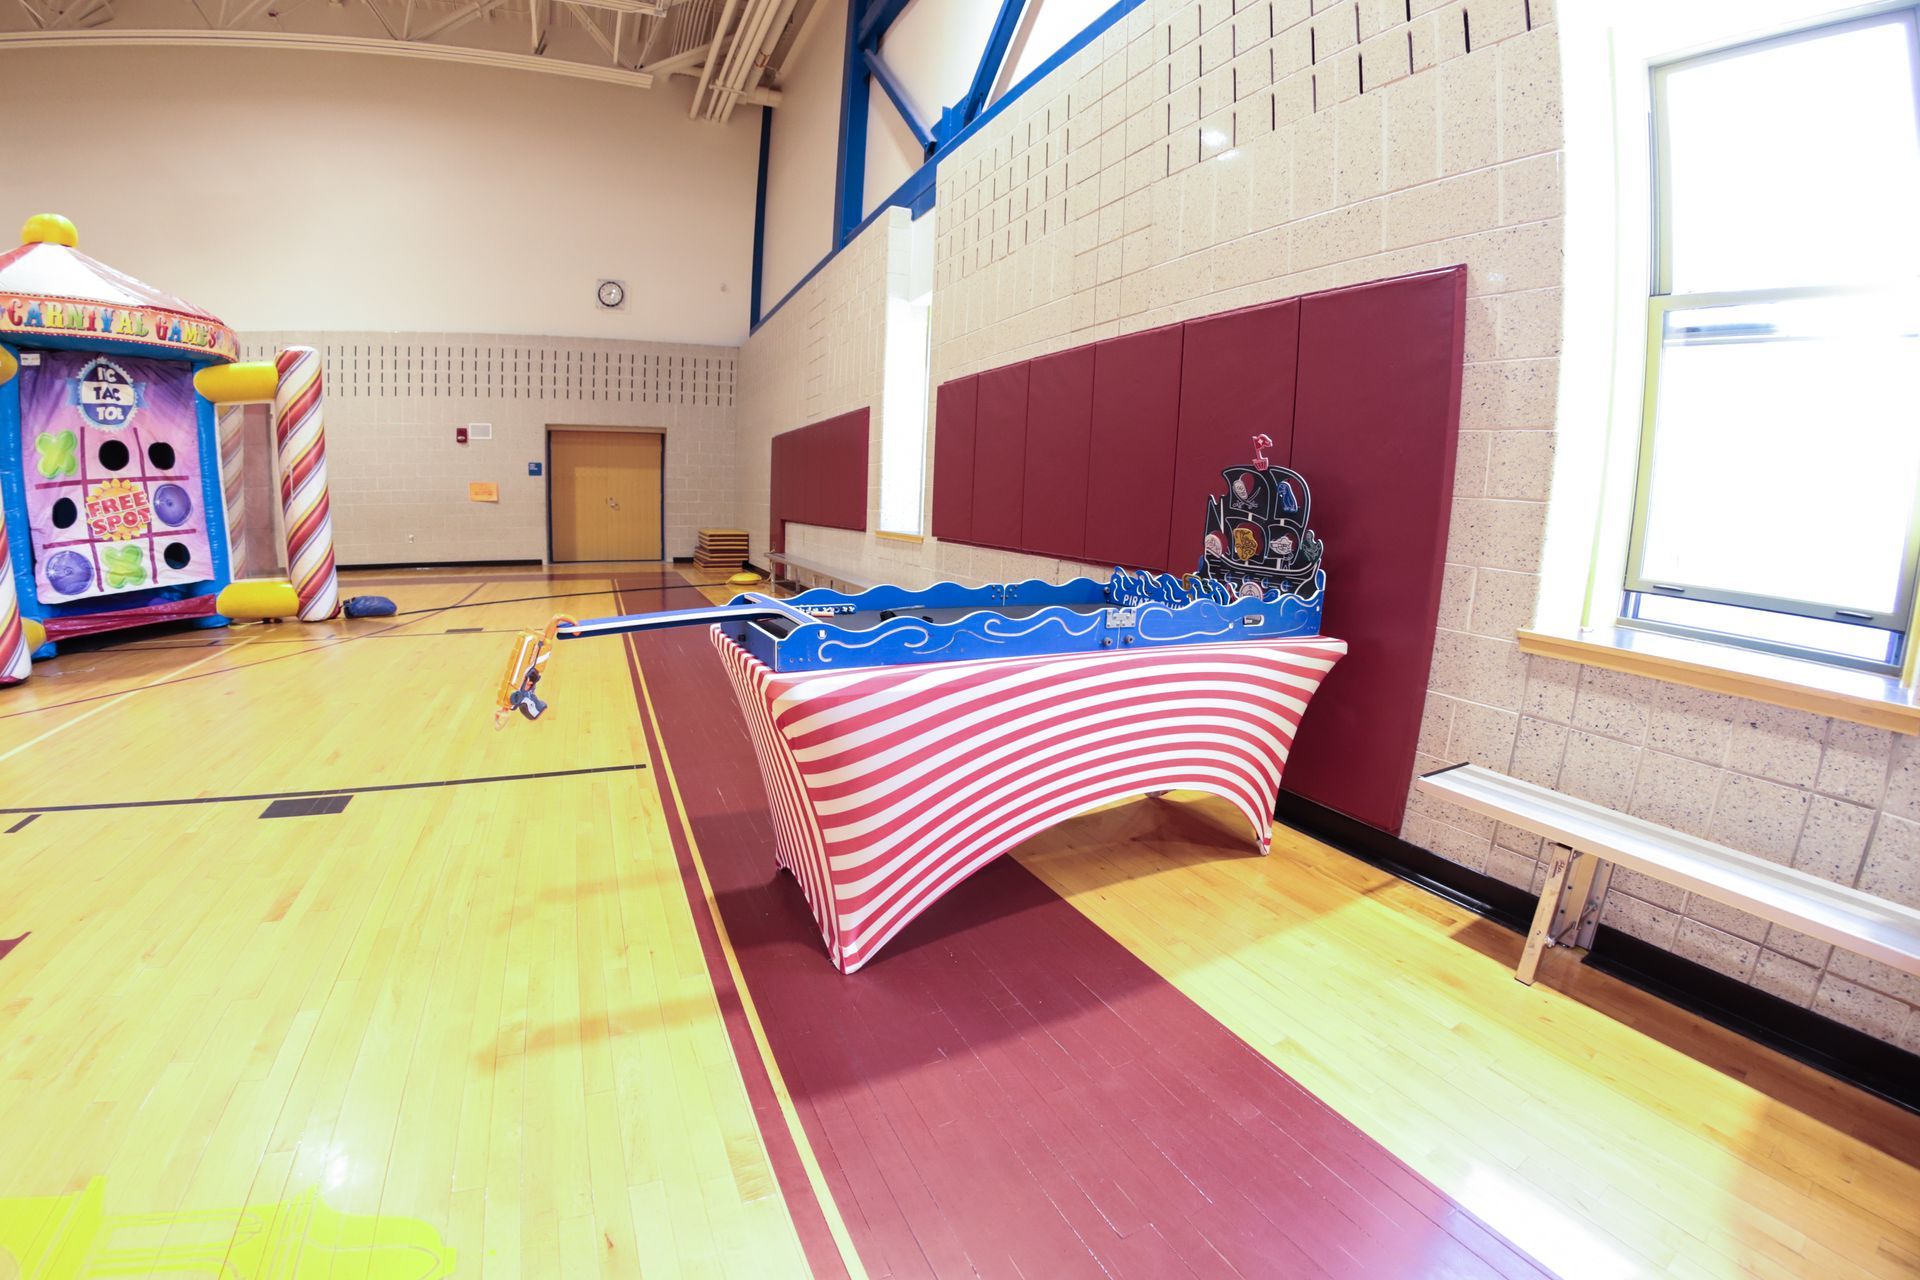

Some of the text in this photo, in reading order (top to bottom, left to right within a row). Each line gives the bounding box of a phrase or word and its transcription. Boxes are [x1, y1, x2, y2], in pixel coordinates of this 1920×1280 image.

[7, 298, 217, 349] CARNIVAL GAMES
[93, 386, 121, 401] TAC
[86, 490, 147, 518] FREE
[92, 507, 151, 535] SPOT
